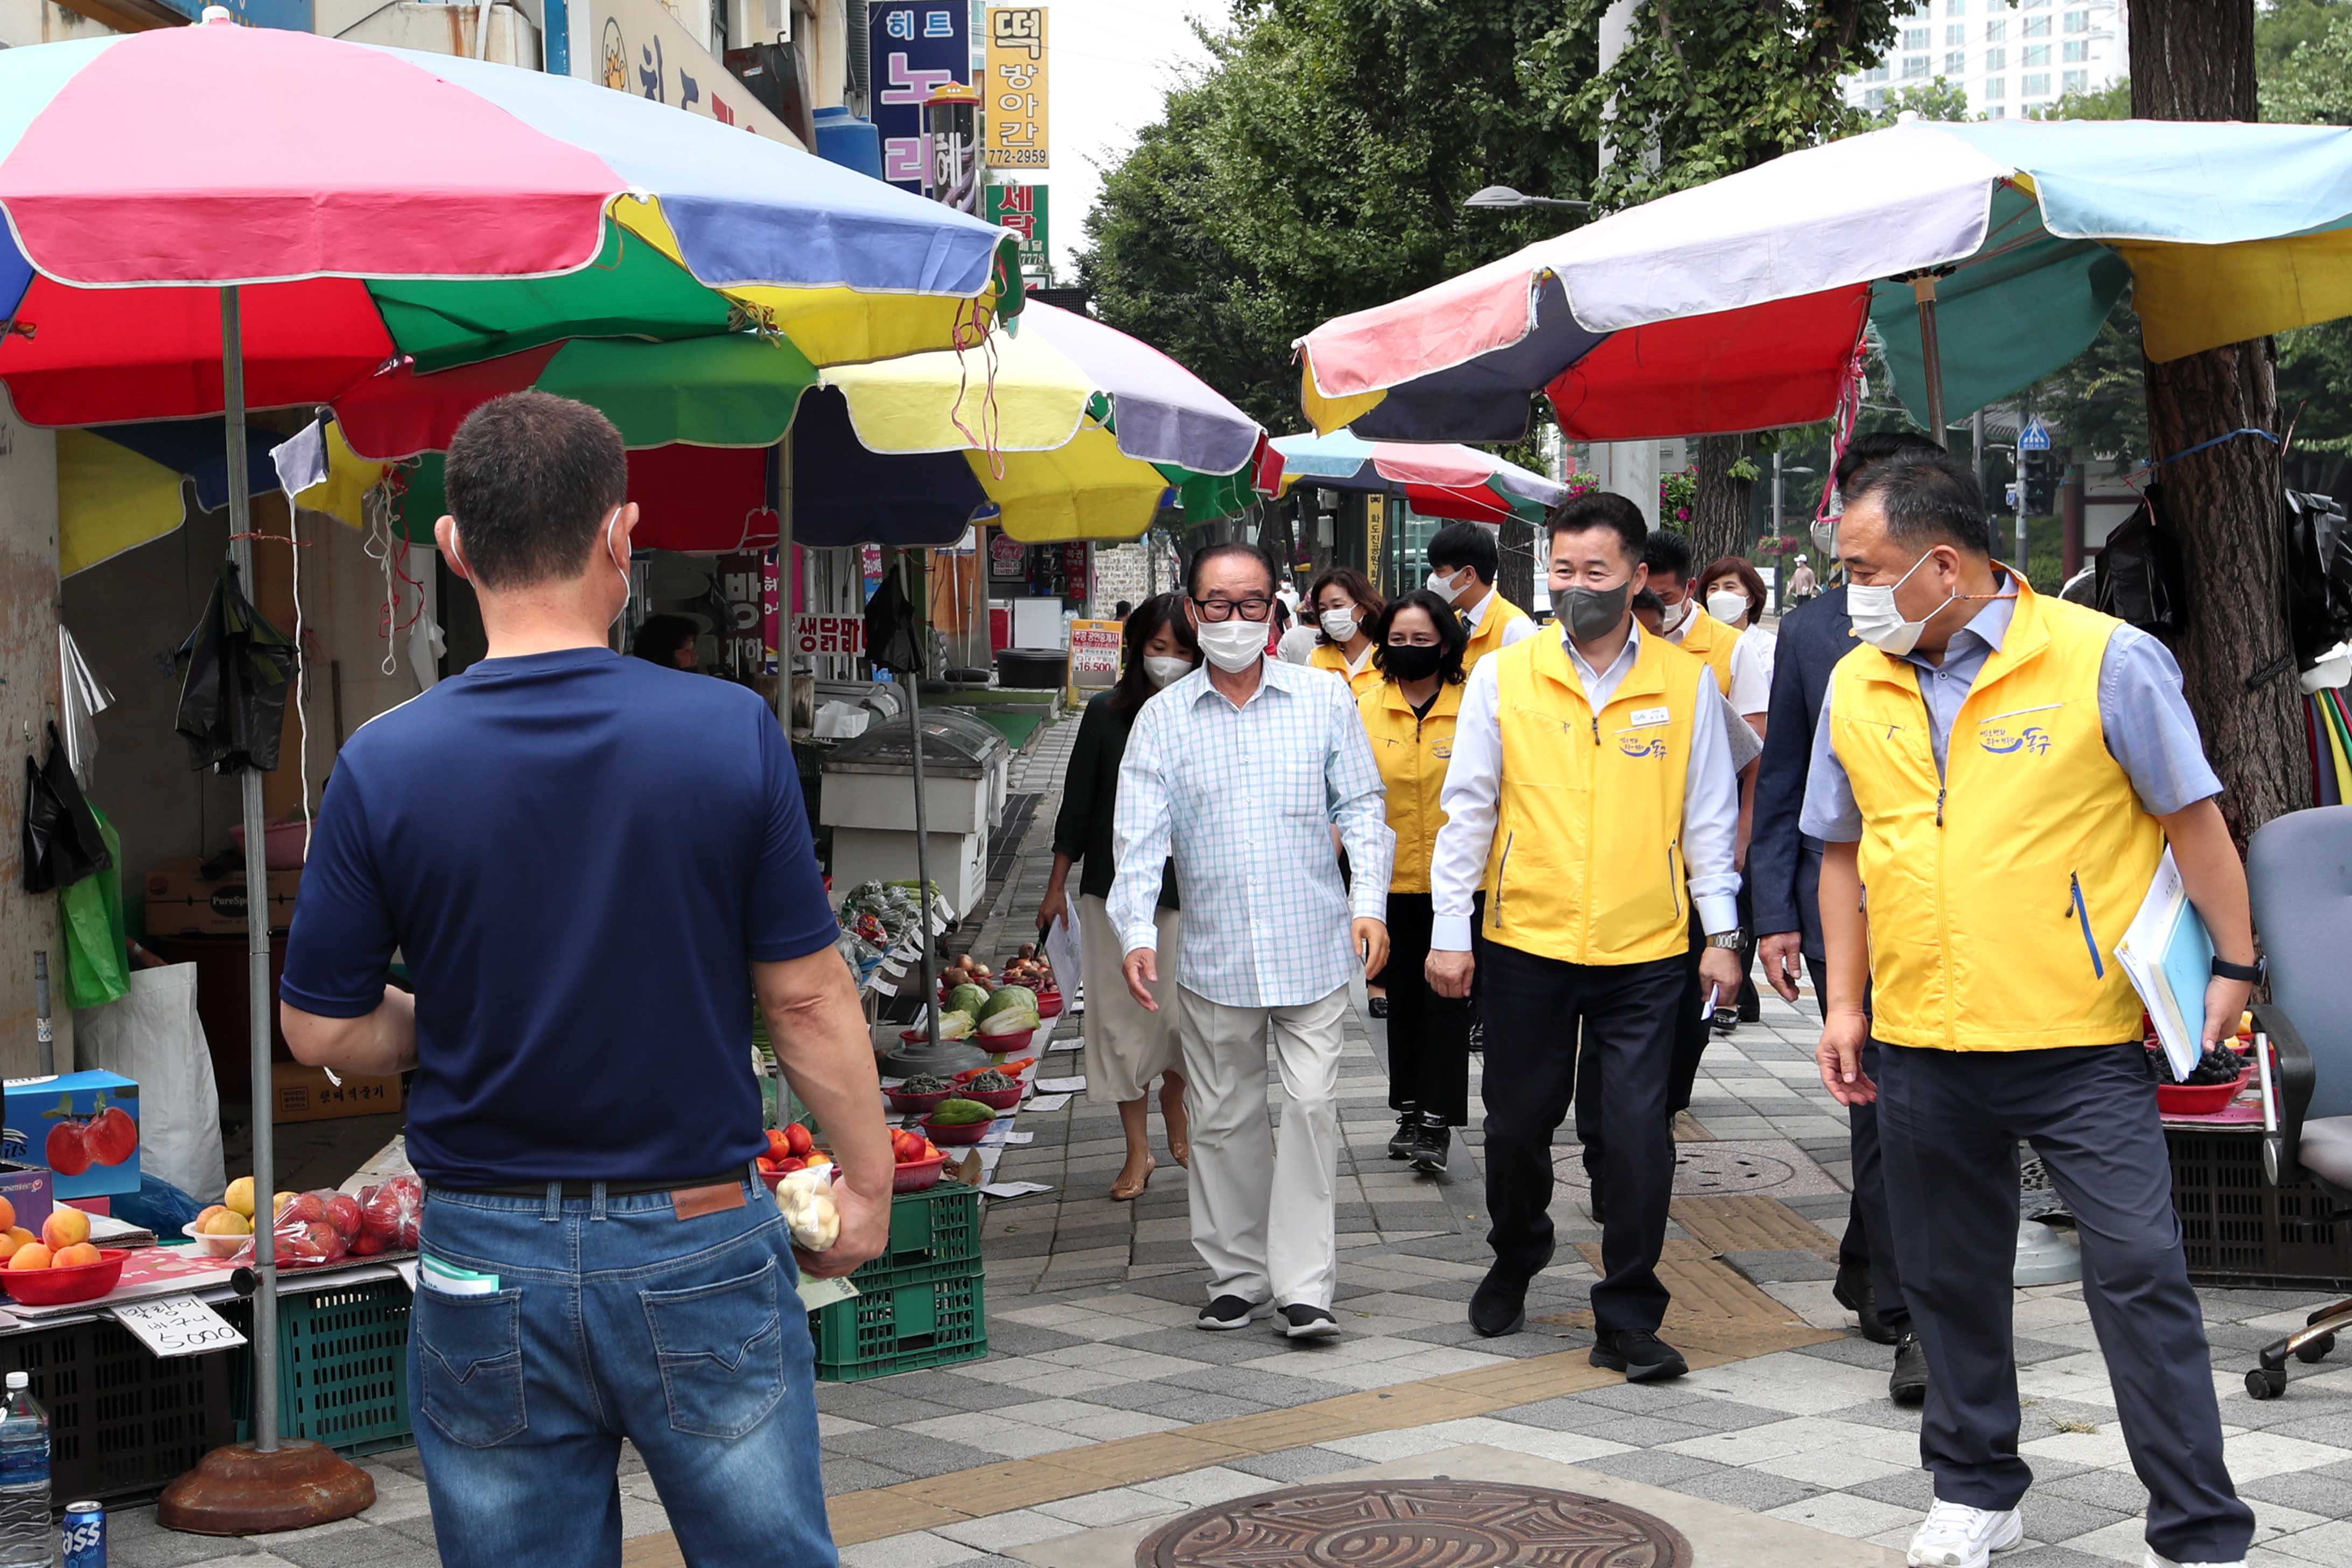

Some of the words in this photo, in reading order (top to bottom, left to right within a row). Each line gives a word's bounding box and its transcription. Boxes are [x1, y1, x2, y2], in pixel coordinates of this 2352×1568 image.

[886, 10, 953, 41] 히트
[989, 149, 1046, 164] 772-2959
[998, 186, 1037, 240] 세탁
[1020, 253, 1045, 264] 7778
[2022, 727, 2052, 756] 동구
[212, 895, 248, 907] PureSp
[3, 1143, 27, 1159] its
[160, 1327, 236, 1349] 5000
[62, 1521, 101, 1556] ass
